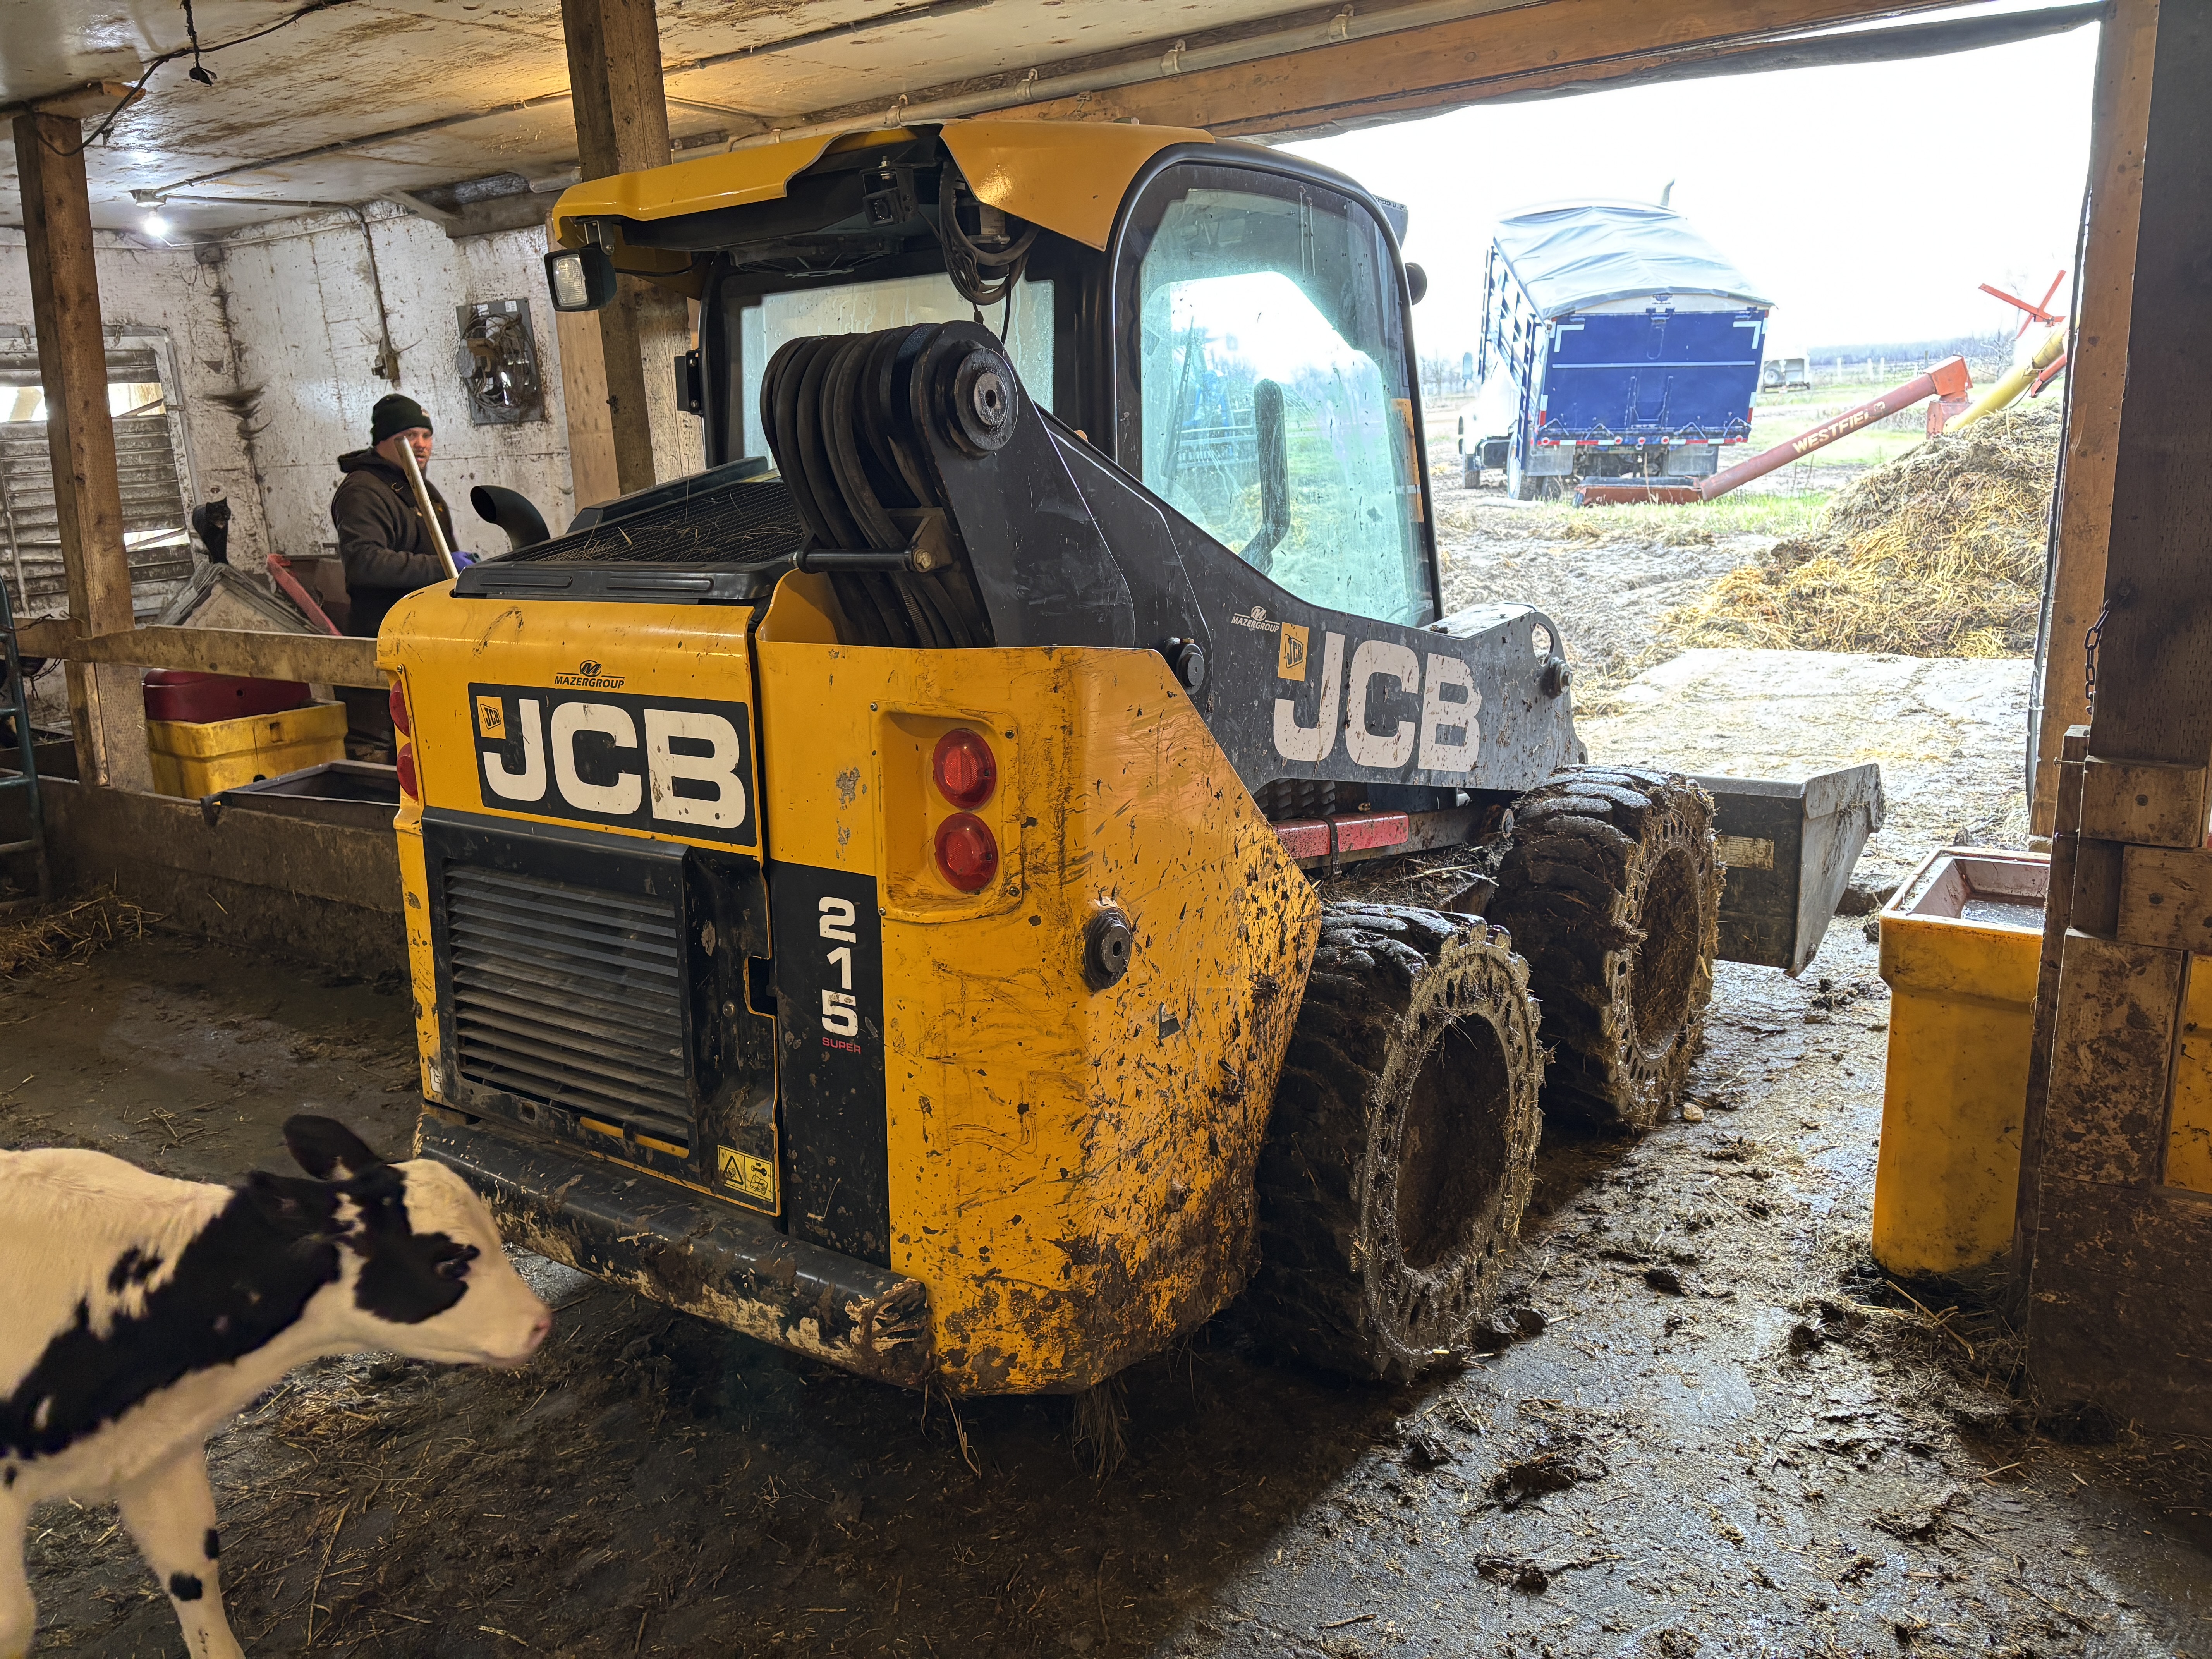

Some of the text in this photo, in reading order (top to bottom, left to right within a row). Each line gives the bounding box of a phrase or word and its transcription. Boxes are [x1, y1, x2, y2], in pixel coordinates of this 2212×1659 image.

[1231, 616, 1279, 632] MAZERGROUP
[1287, 636, 1302, 665] JCB
[554, 676, 625, 689] MAZERGROUP
[1273, 631, 1482, 772] JCB
[484, 707, 500, 727] JCB
[483, 699, 746, 828] JCB
[819, 896, 858, 1037] 215
[822, 1037, 861, 1054] SUPER
